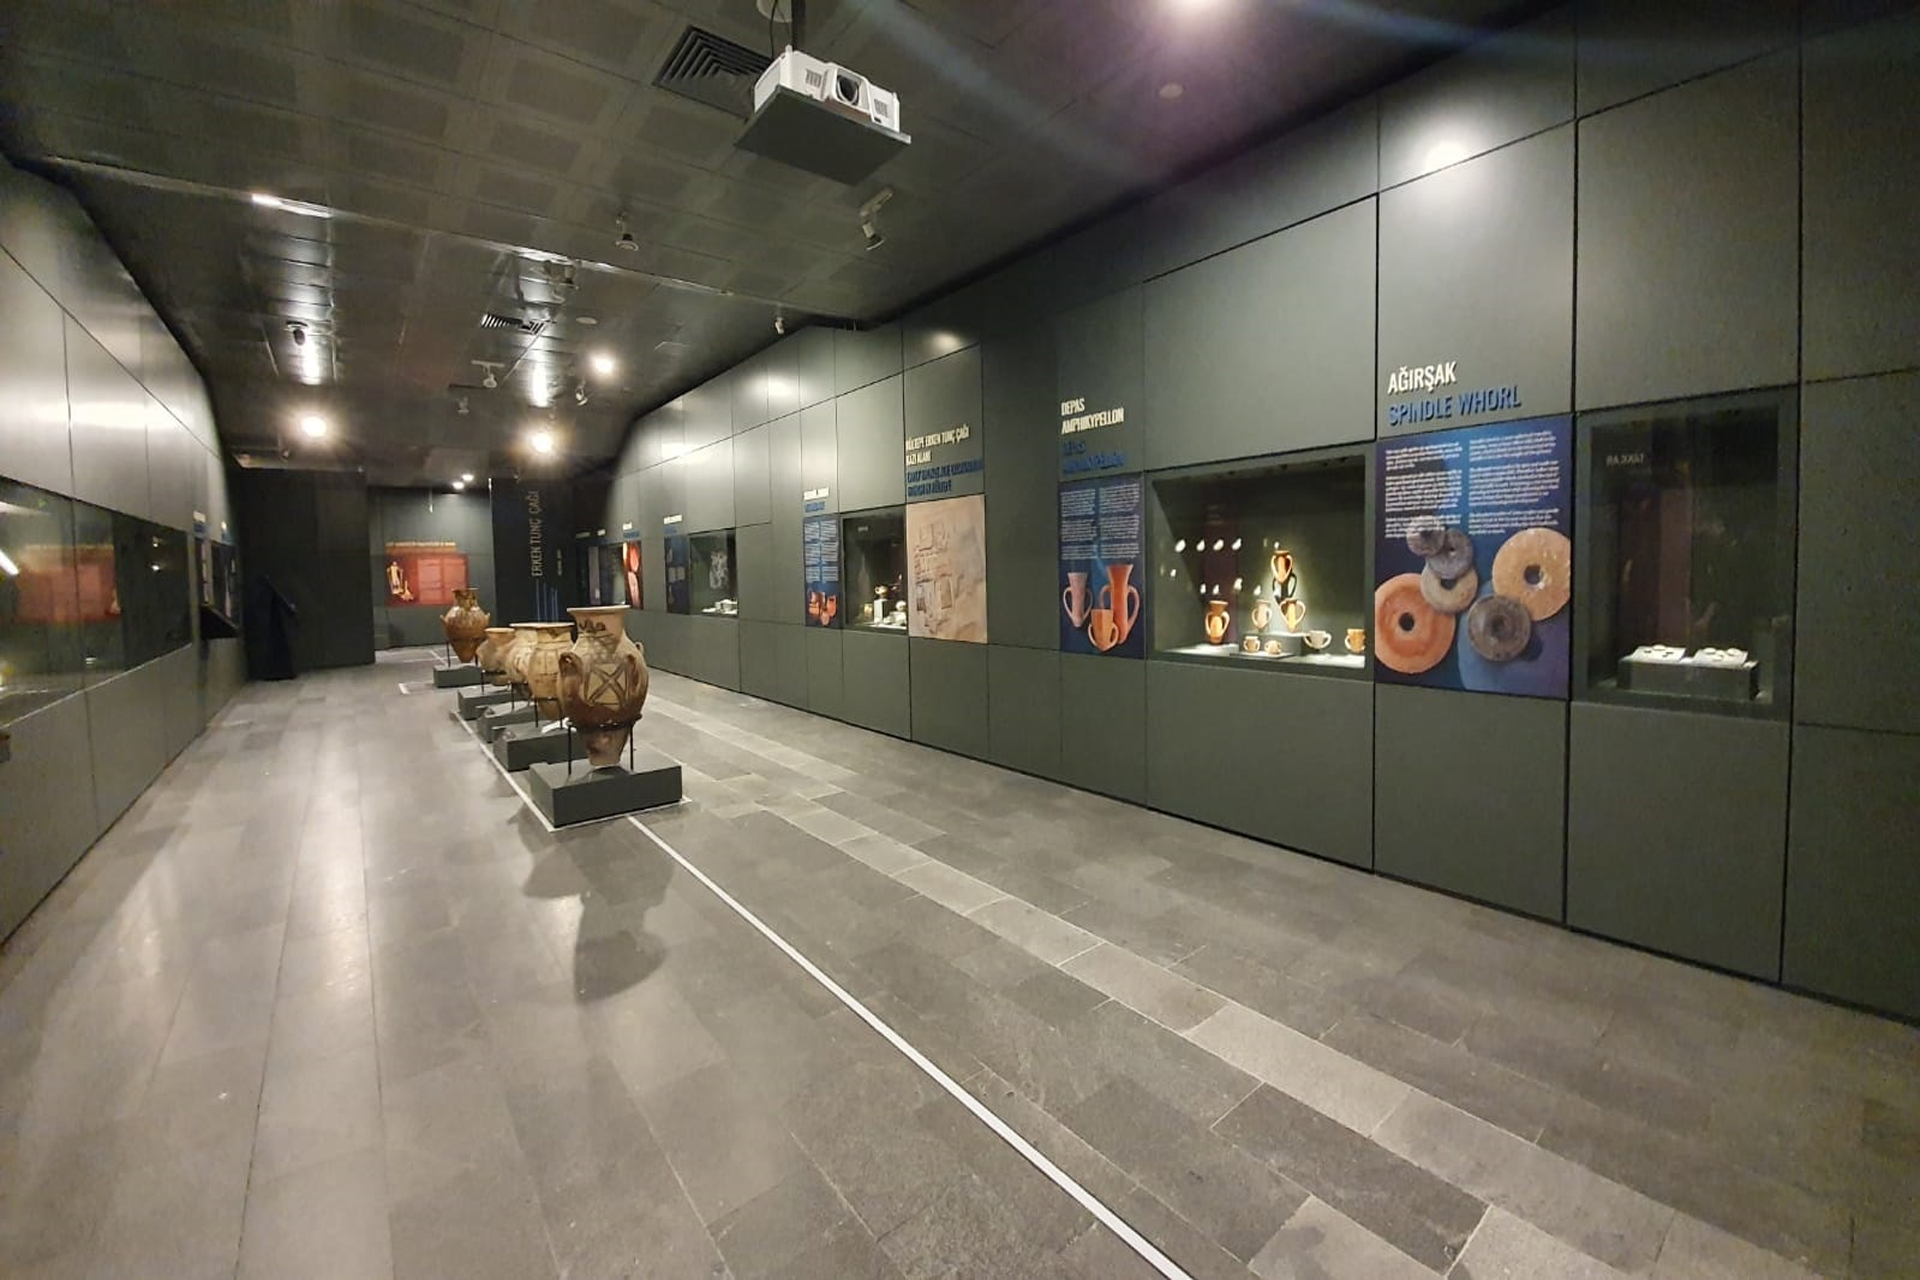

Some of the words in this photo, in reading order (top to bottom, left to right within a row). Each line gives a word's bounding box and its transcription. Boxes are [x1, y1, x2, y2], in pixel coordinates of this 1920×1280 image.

[1387, 361, 1457, 394] AĞIRŞAK
[1061, 398, 1085, 416] DEPAS
[1389, 397, 1452, 426] SPINDLE
[1459, 386, 1522, 414] WHORL
